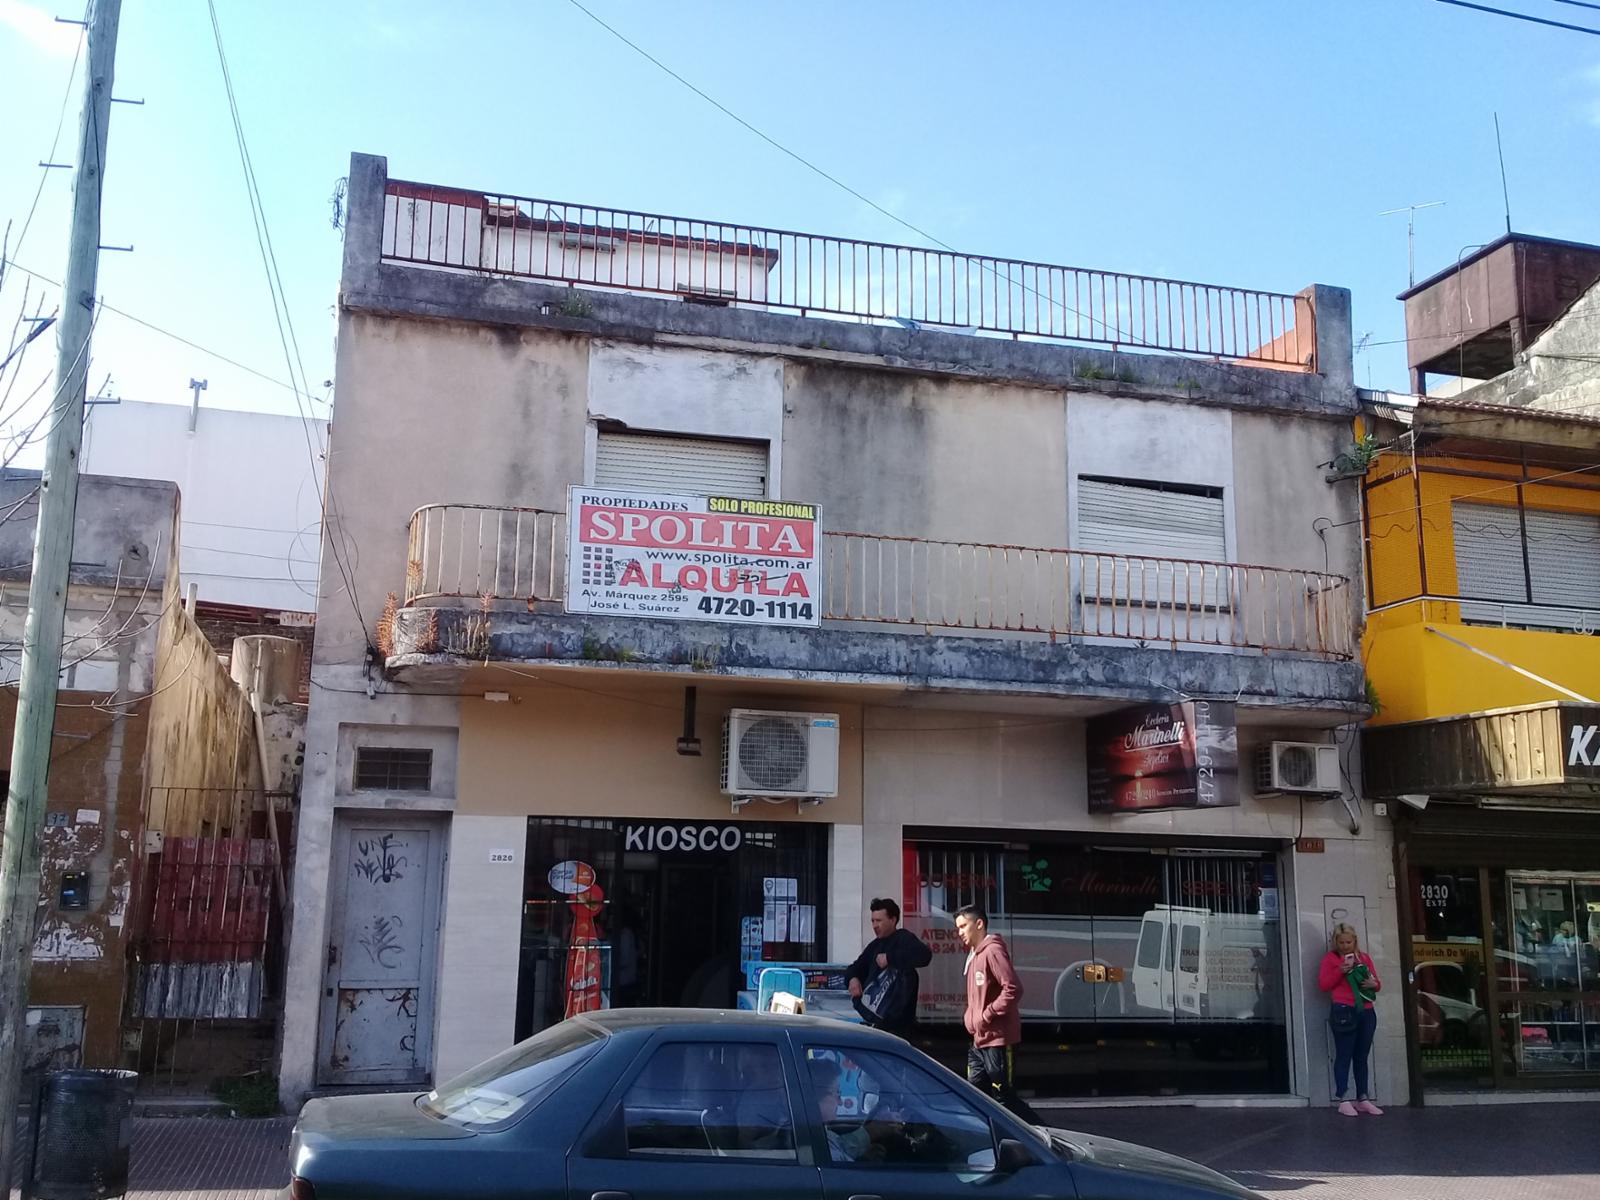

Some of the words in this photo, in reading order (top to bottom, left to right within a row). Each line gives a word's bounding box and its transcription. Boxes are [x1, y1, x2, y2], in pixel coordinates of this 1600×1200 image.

[581, 495, 689, 512] PROPIEDADES
[709, 497, 739, 512] SOLO
[740, 500, 815, 519] PROFESIONAL
[589, 510, 806, 553] SPOLITA
[646, 550, 813, 570] www.spolita.com.ar
[618, 560, 811, 598] ALQUILA
[581, 589, 601, 598] Av.
[660, 593, 689, 602] 2595
[590, 600, 620, 609] José
[638, 602, 681, 613] Suárez
[697, 596, 813, 620] 4720-1114
[1124, 721, 1185, 750] Marinelli
[1568, 725, 1600, 766] K
[625, 825, 742, 851] KIOSCO
[1420, 884, 1449, 899] 2830
